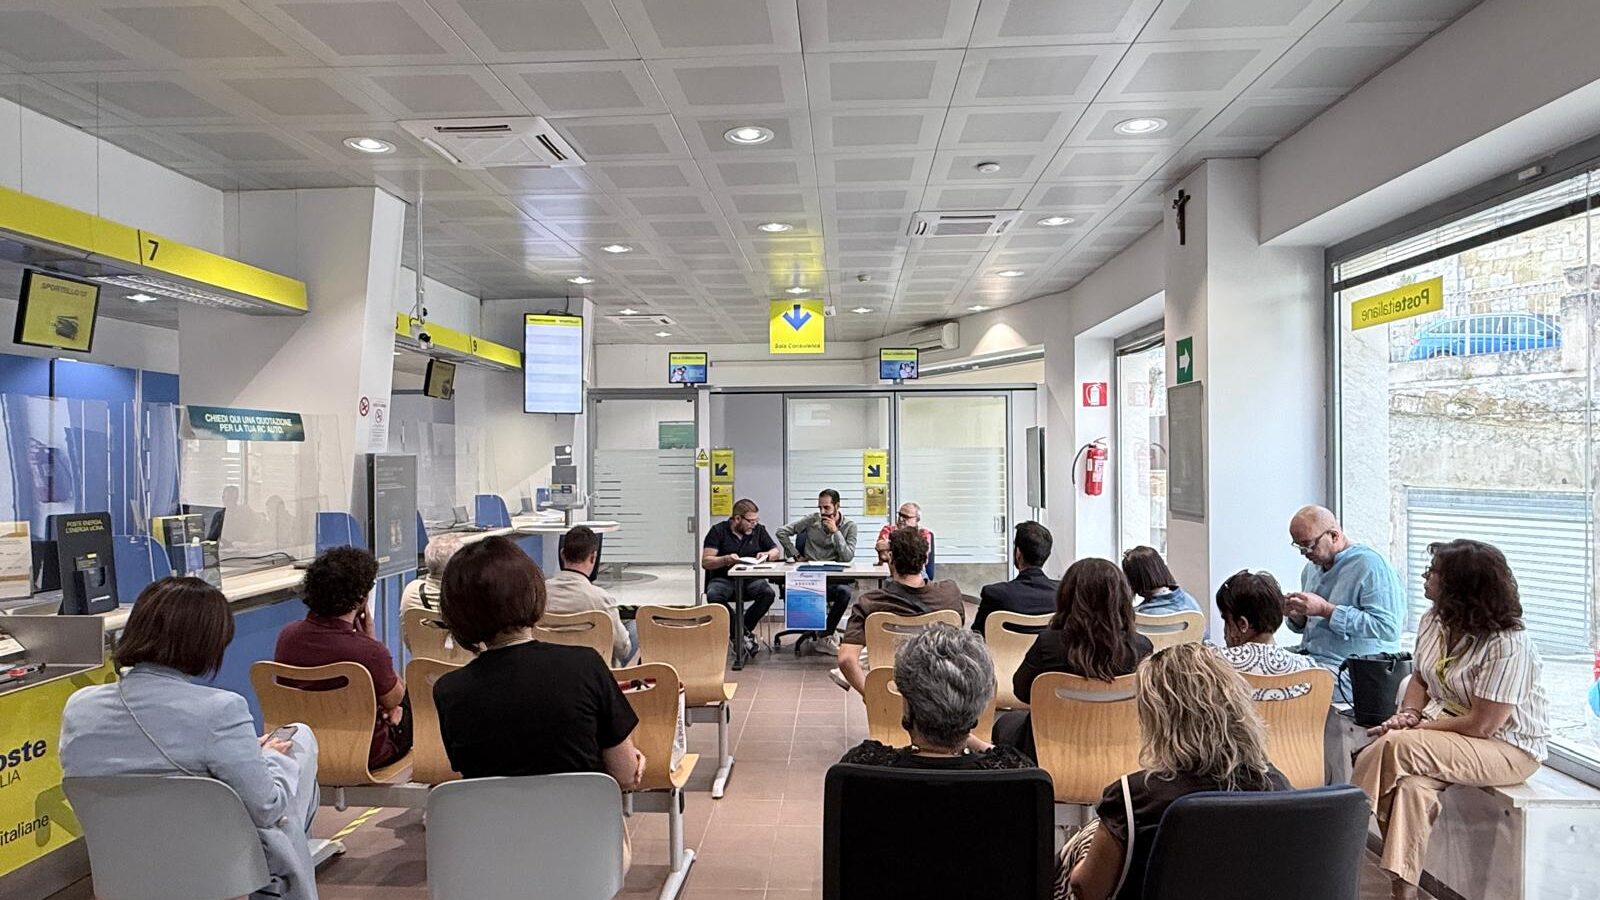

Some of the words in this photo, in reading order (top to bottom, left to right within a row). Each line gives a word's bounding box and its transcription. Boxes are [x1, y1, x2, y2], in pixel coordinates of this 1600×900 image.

[148, 239, 159, 261] 7
[473, 339, 478, 352] 9
[204, 413, 229, 423] CHIEDI
[229, 414, 242, 424] QUI
[242, 416, 256, 425] UNA
[256, 416, 293, 427] QUOTAZIONE
[219, 423, 234, 432] PER
[234, 424, 243, 432] LA
[243, 424, 257, 433] TUA
[257, 425, 266, 433] RC
[266, 425, 284, 434] AUTO.
[0, 814, 49, 847] italiane
